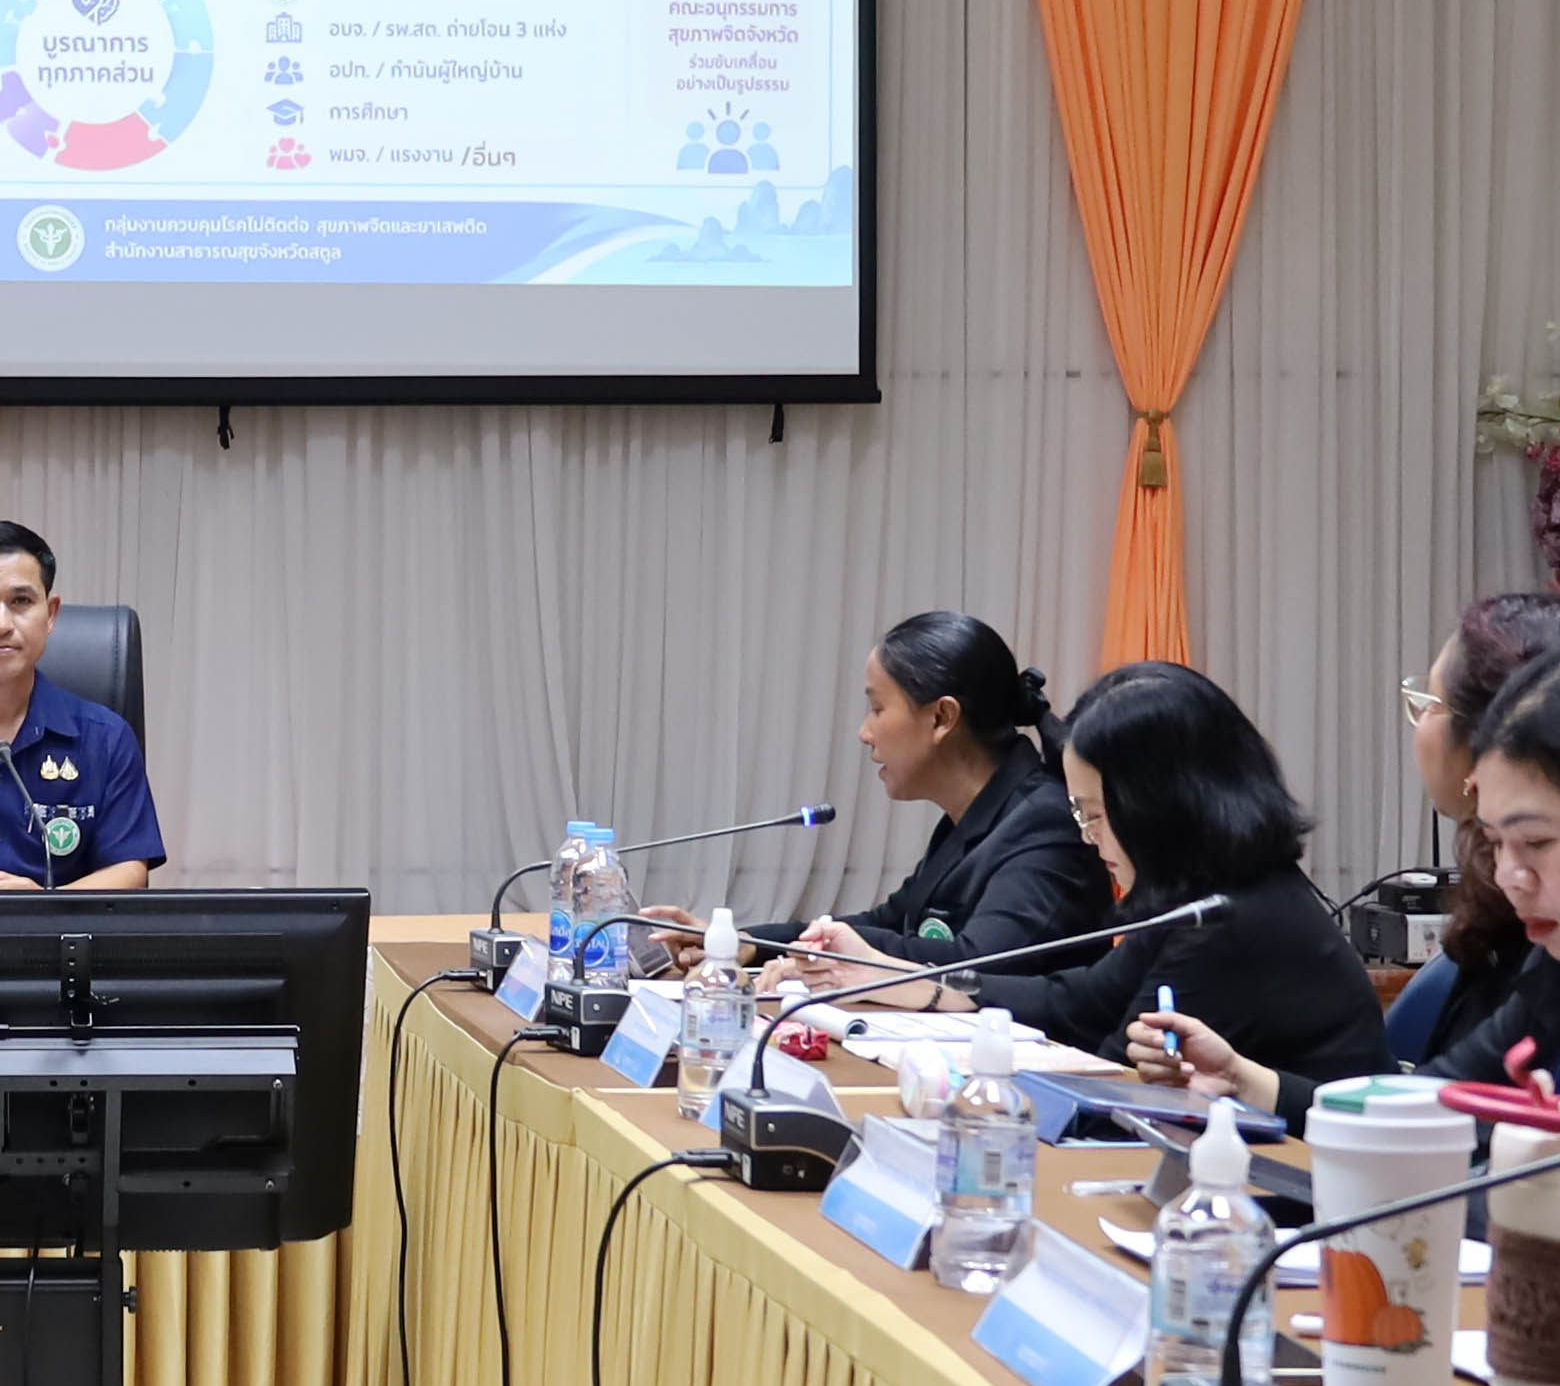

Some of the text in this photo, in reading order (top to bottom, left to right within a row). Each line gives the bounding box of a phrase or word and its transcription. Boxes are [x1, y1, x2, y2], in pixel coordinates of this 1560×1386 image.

[669, 0, 798, 22] คณะอนุกรรมการ
[328, 20, 368, 38] อบจ.
[516, 21, 528, 38] 3
[533, 20, 567, 39] แห่ง
[668, 25, 799, 47] สุขภาพจิตจังหวัด
[42, 32, 149, 60] บูรณาการ
[38, 59, 154, 89] ทุกภาคส่วน
[328, 61, 373, 79] อปท.
[390, 60, 523, 84] กำนันผู้ใหญ่บ้าน
[328, 102, 409, 122] การศึกษา
[328, 145, 369, 164] พมจ.
[390, 147, 453, 164] แรงงาน
[104, 213, 310, 238] กลุ่มงานควบคุมโรคไม่ติดต่อ
[551, 989, 573, 1010] NPE
